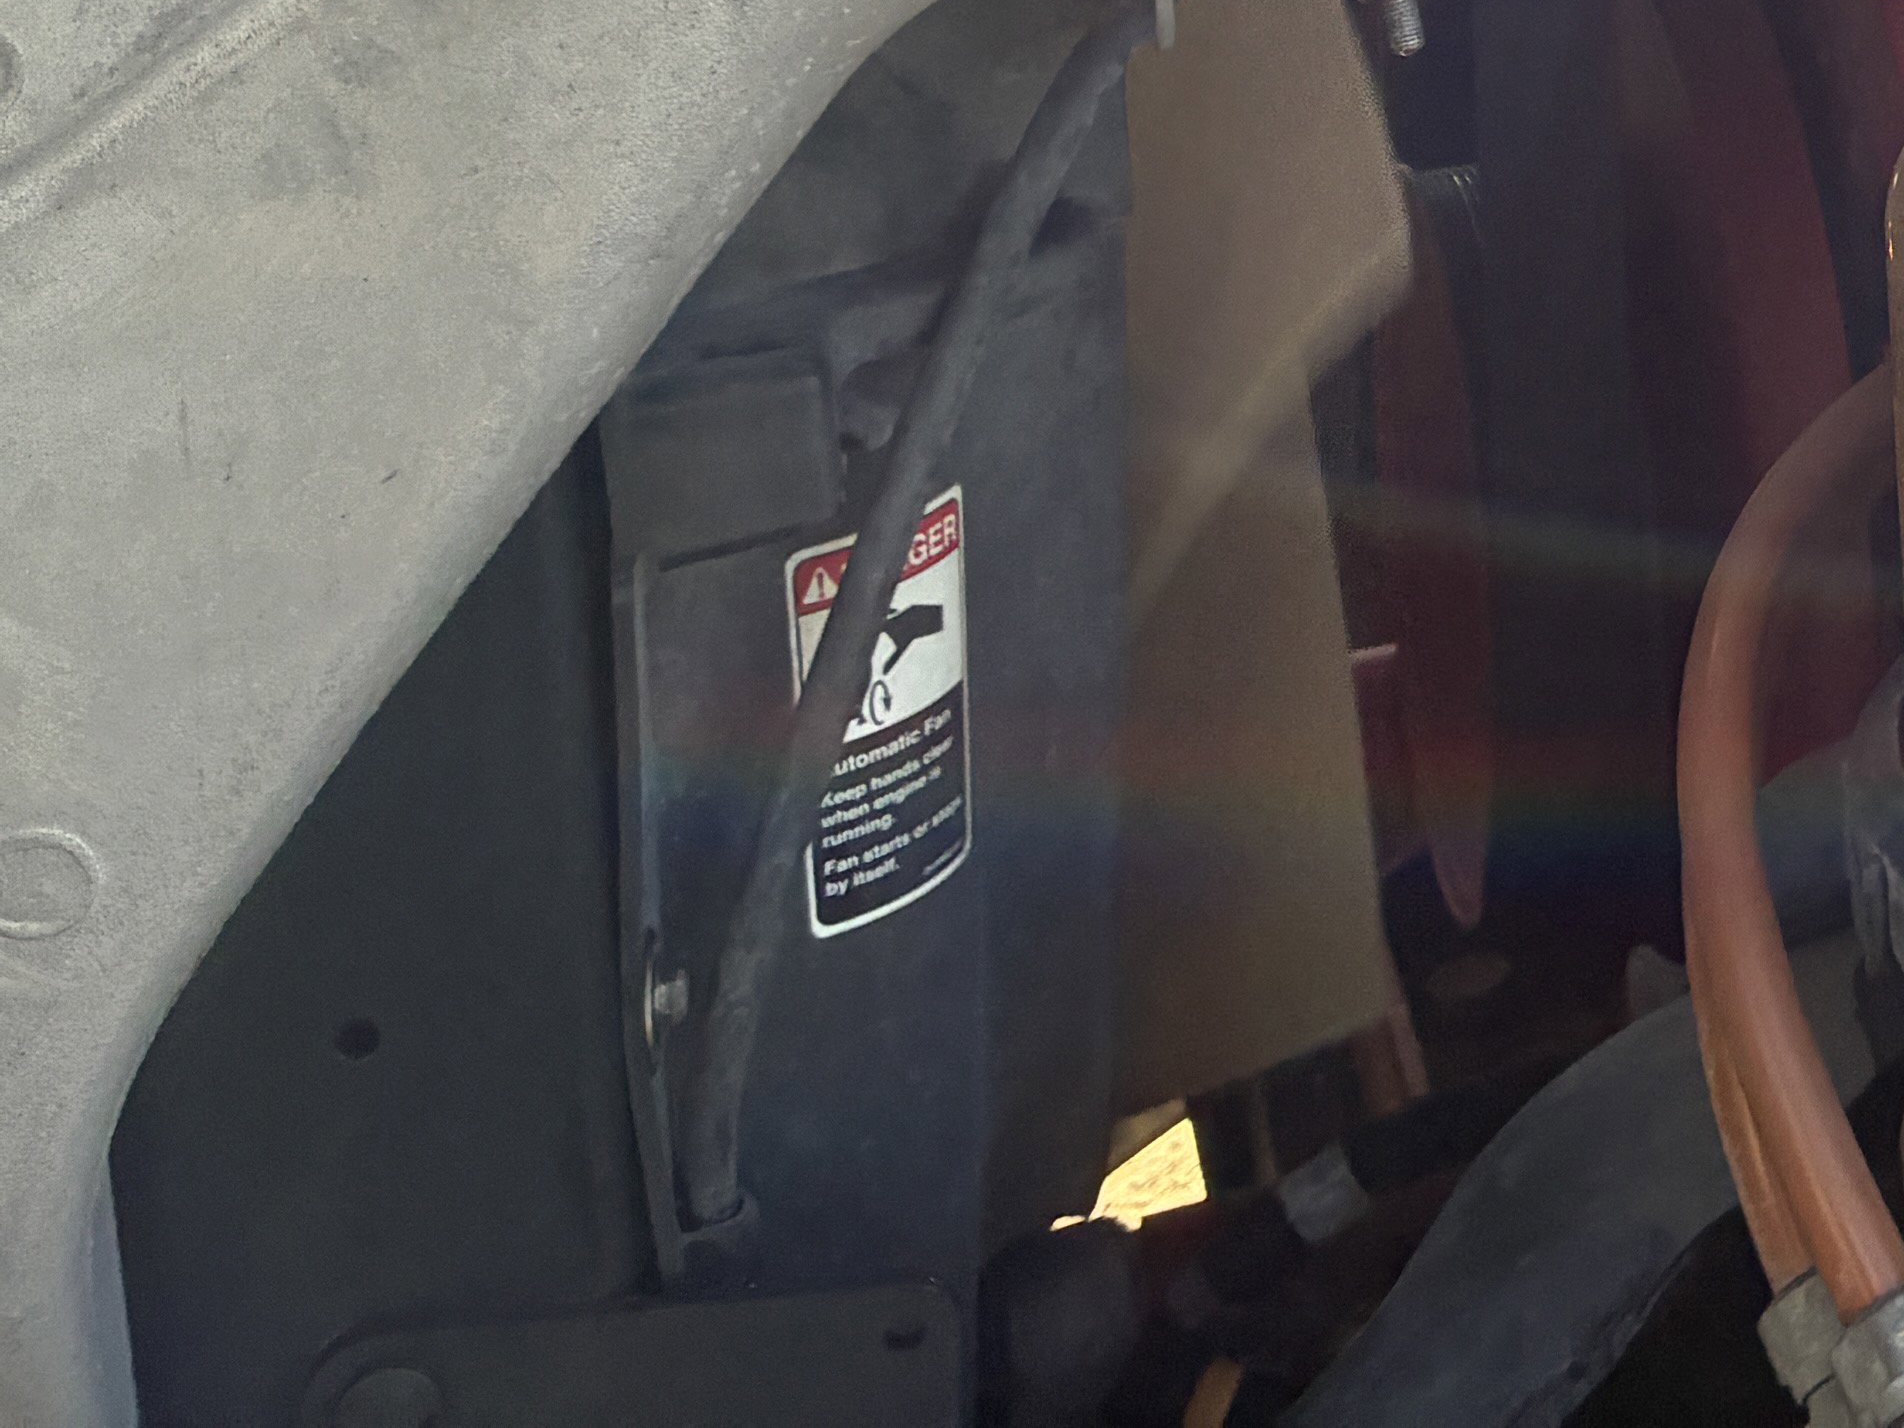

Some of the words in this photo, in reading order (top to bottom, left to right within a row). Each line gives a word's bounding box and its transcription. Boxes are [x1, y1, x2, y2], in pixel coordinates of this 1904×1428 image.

[906, 513, 959, 565] GER
[832, 729, 922, 777] utomatic
[924, 709, 952, 736] Fan
[820, 784, 868, 808] Keep
[870, 760, 921, 791] hands
[821, 803, 870, 829] when
[824, 855, 859, 877] Fan
[824, 878, 849, 897] by
